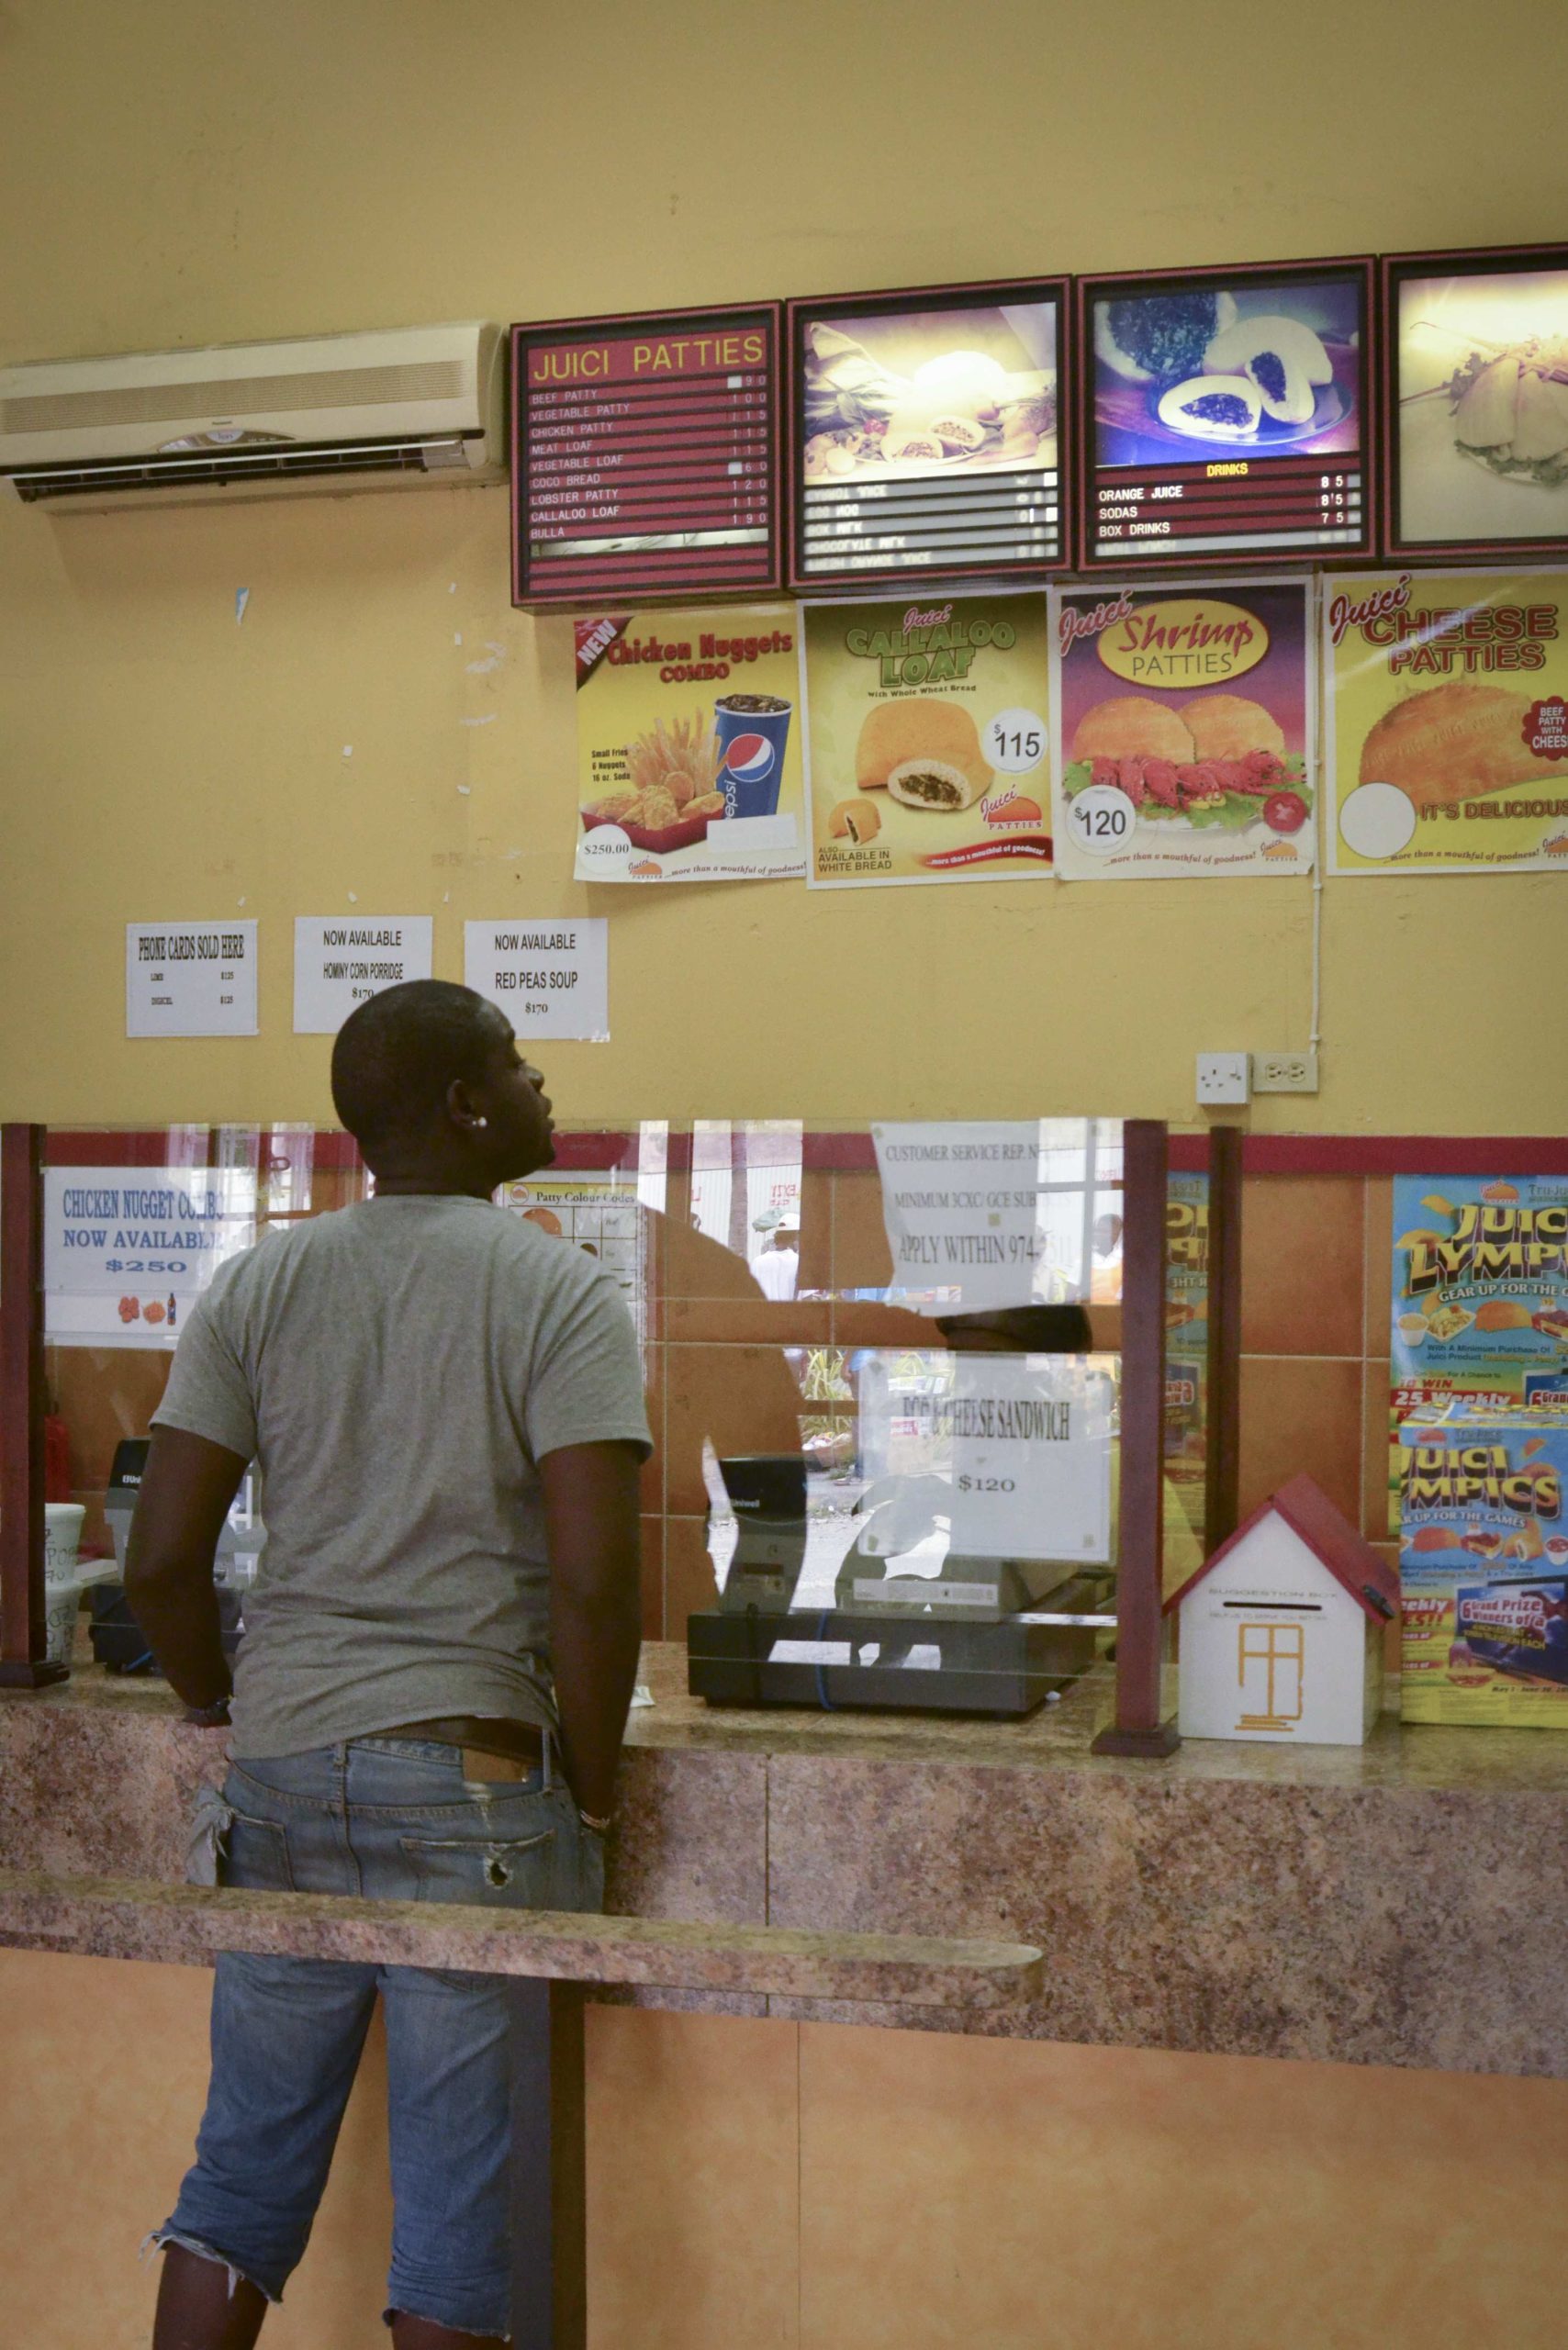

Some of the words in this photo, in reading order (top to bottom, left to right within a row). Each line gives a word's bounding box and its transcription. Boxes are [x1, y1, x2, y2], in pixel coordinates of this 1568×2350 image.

[533, 349, 609, 381] JUICI
[633, 335, 763, 373] PATTIES
[532, 393, 556, 405] BEEF
[565, 389, 598, 402] PATTY
[532, 406, 589, 421] VEGETABLE
[597, 403, 631, 417] PATTY
[532, 425, 574, 439] CHICKEN
[580, 422, 614, 435] PATTY
[532, 443, 557, 455] MEAT
[566, 441, 593, 453] LOAF
[532, 458, 589, 473] VEGETABLE
[597, 454, 624, 466] LOAF
[1206, 463, 1249, 477] DRINKS
[532, 477, 560, 488] COCO
[566, 474, 600, 487] BREAD
[532, 493, 579, 506] LOBSTER
[586, 489, 619, 502] PATTY
[1099, 487, 1145, 502] ORANGE
[1151, 485, 1183, 499] JUICE
[532, 509, 587, 522] CALLALOO
[592, 506, 621, 518] LOAF
[1099, 506, 1138, 520] SODAS
[531, 527, 565, 540] BULLA
[1099, 525, 1122, 537] BOX
[1129, 521, 1170, 535] DRINKS
[1329, 573, 1411, 646] Juici
[904, 604, 953, 633] Juici
[1058, 589, 1133, 657] Juici
[1361, 604, 1559, 646] CHEESE
[577, 619, 618, 666] NEW
[846, 620, 1016, 658] CALLALOO
[1117, 613, 1254, 657] Shrimp
[606, 635, 692, 666] Chicken
[699, 630, 792, 663] Nuggets
[879, 646, 977, 688] LOAF
[1132, 652, 1233, 677] PATTIES
[1388, 643, 1546, 675] PATTIES
[660, 661, 731, 683] COMBO
[868, 690, 889, 699] With
[890, 688, 917, 698] Whole
[920, 686, 948, 696] Wheat
[950, 685, 977, 693] Bread
[1540, 706, 1564, 718] BEEF
[1538, 716, 1567, 726] PATTY
[1540, 725, 1563, 734] WITH
[591, 748, 610, 759] Small
[611, 747, 629, 757] Fries
[599, 760, 626, 772] Nuggets
[613, 772, 631, 781] Soda
[980, 783, 1018, 822] Juici
[1420, 800, 1460, 821] IT'S
[989, 821, 1043, 831] PATTIES
[1074, 807, 1126, 836] $120
[584, 843, 630, 856] $250.00
[818, 851, 877, 863] AVAILABLE
[879, 850, 890, 860] IN
[971, 846, 1002, 860] mouthful
[1413, 849, 1434, 859] than
[1444, 849, 1484, 861] mouthful
[1485, 850, 1495, 863] of
[1496, 847, 1540, 863] goodness!
[818, 861, 853, 872] WHITE
[855, 860, 892, 871] BREAD
[1133, 852, 1153, 861] than
[1162, 852, 1202, 864] mouthful
[1204, 854, 1213, 866] of
[1214, 851, 1257, 866] goodness!
[693, 865, 712, 875] than
[720, 864, 756, 876] mouthful
[757, 865, 767, 877] of
[768, 861, 807, 876] goodness!
[322, 930, 347, 946] NOW
[348, 930, 402, 946] AVAILABLE
[495, 934, 520, 950] NOW
[521, 934, 577, 950] AVAILABLE
[139, 935, 166, 961] PHONE
[168, 934, 196, 960] CARDS
[197, 934, 219, 959] SOLD
[220, 934, 245, 959] HERE
[322, 962, 348, 979] HOMINY
[350, 962, 368, 979] CORN
[369, 962, 404, 979] PORRIDGE
[495, 972, 517, 990] RED
[520, 971, 547, 989] PEAS
[549, 971, 578, 989] SOUP
[525, 1002, 548, 1014] $170
[885, 1144, 950, 1162] CUSTOMER
[952, 1144, 1000, 1161] SERVICE
[1002, 1144, 1025, 1160] REP.
[62, 1189, 119, 1219] CHICKEN
[123, 1189, 174, 1219] NUGGET
[536, 1192, 563, 1204] Patty
[565, 1192, 599, 1203] Colour
[604, 1192, 635, 1203] Codes
[987, 1192, 1010, 1208] GCE
[63, 1229, 108, 1248] NOW
[898, 1236, 940, 1264] APPLY
[946, 1236, 1005, 1264] WITHIN
[106, 1259, 187, 1273] $250
[1439, 1284, 1476, 1303] GEAR
[1477, 1284, 1499, 1296] UP
[1500, 1283, 1529, 1295] FOR
[1532, 1284, 1558, 1296] THE
[1449, 1354, 1482, 1363] Product
[1457, 1346, 1496, 1356] Minimum
[1497, 1346, 1539, 1357] Purchase
[1423, 1379, 1453, 1389] WIN
[1394, 1391, 1424, 1406] 25
[944, 1398, 994, 1438] CHEESE
[997, 1400, 1070, 1441] SANDWICH
[958, 1474, 1015, 1493] $120
[1414, 1512, 1430, 1521] UP
[1434, 1511, 1458, 1521] FOR
[1461, 1510, 1481, 1521] THE
[1484, 1513, 1526, 1528] GAMES
[1208, 1588, 1304, 1598] SUGGESTION
[1471, 1601, 1498, 1610] Grand
[1502, 1598, 1540, 1611] Prize
[1473, 1611, 1513, 1624] Winners
